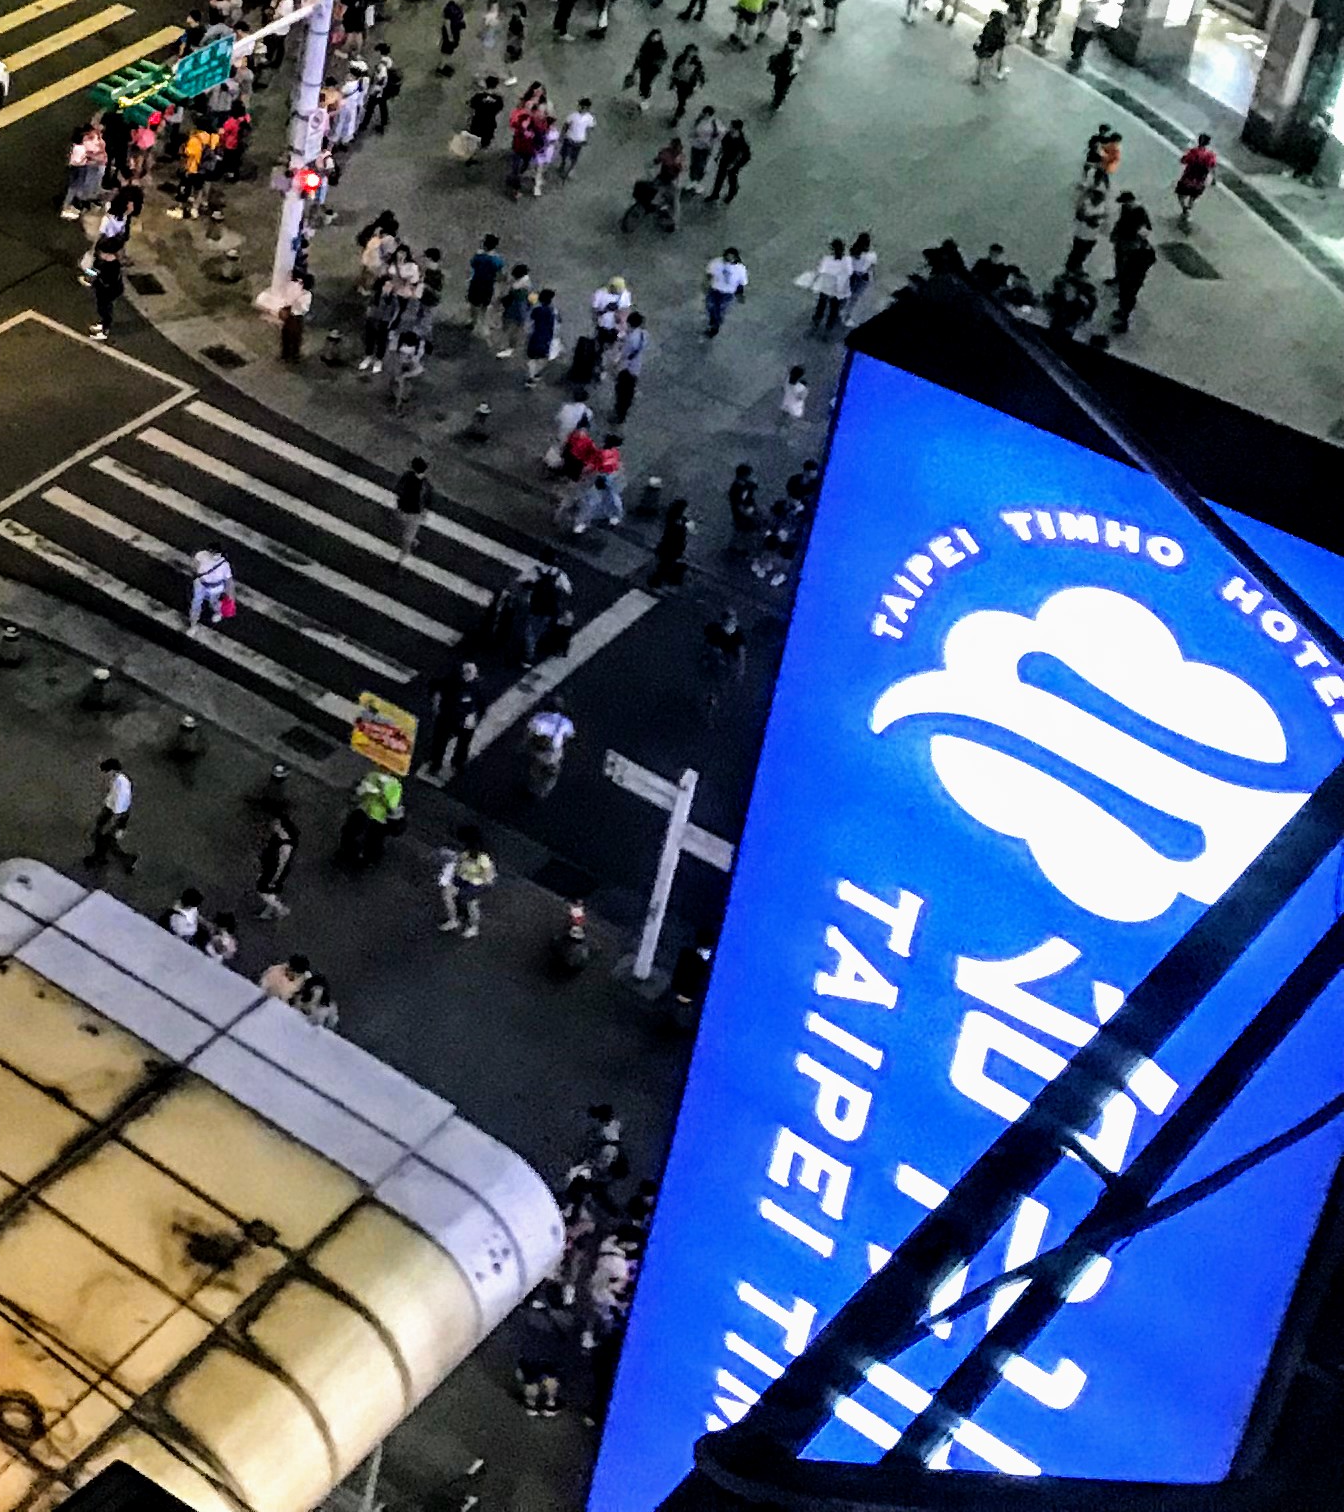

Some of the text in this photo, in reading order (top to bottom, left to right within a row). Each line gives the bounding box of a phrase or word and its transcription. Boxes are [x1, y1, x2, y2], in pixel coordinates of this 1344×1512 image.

[870, 527, 981, 640] TAIPEI
[999, 509, 1185, 568] TIMHO
[758, 878, 925, 1259] TAIPEI
